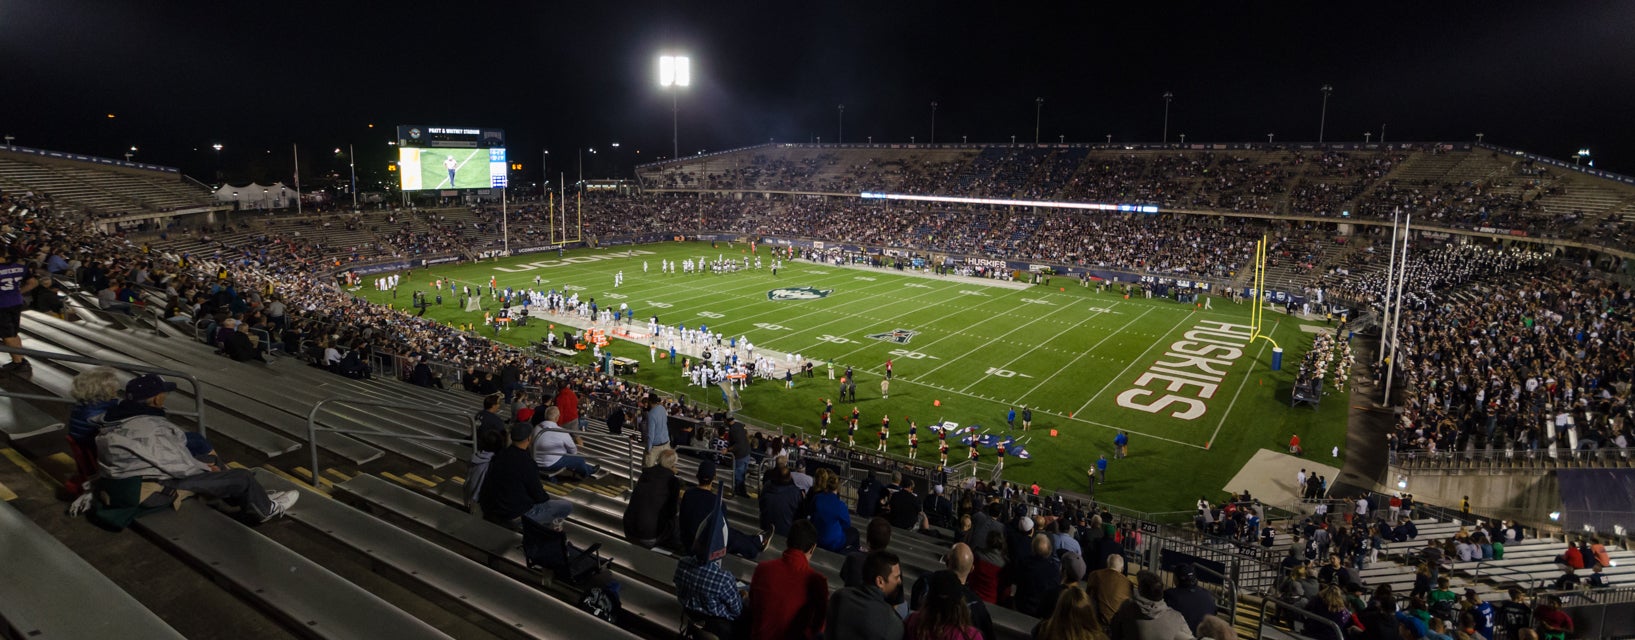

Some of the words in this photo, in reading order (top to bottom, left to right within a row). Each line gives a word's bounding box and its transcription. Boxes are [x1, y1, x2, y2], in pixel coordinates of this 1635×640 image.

[883, 249, 909, 258] UCON
[492, 250, 657, 272] UCONN
[968, 258, 1006, 268] HUSKIES
[753, 322, 783, 330] 40
[816, 334, 849, 344] 30
[888, 349, 927, 359] 20
[985, 367, 1016, 378] 10
[1115, 320, 1257, 421] HUSKIES
[1143, 524, 1155, 532] 205
